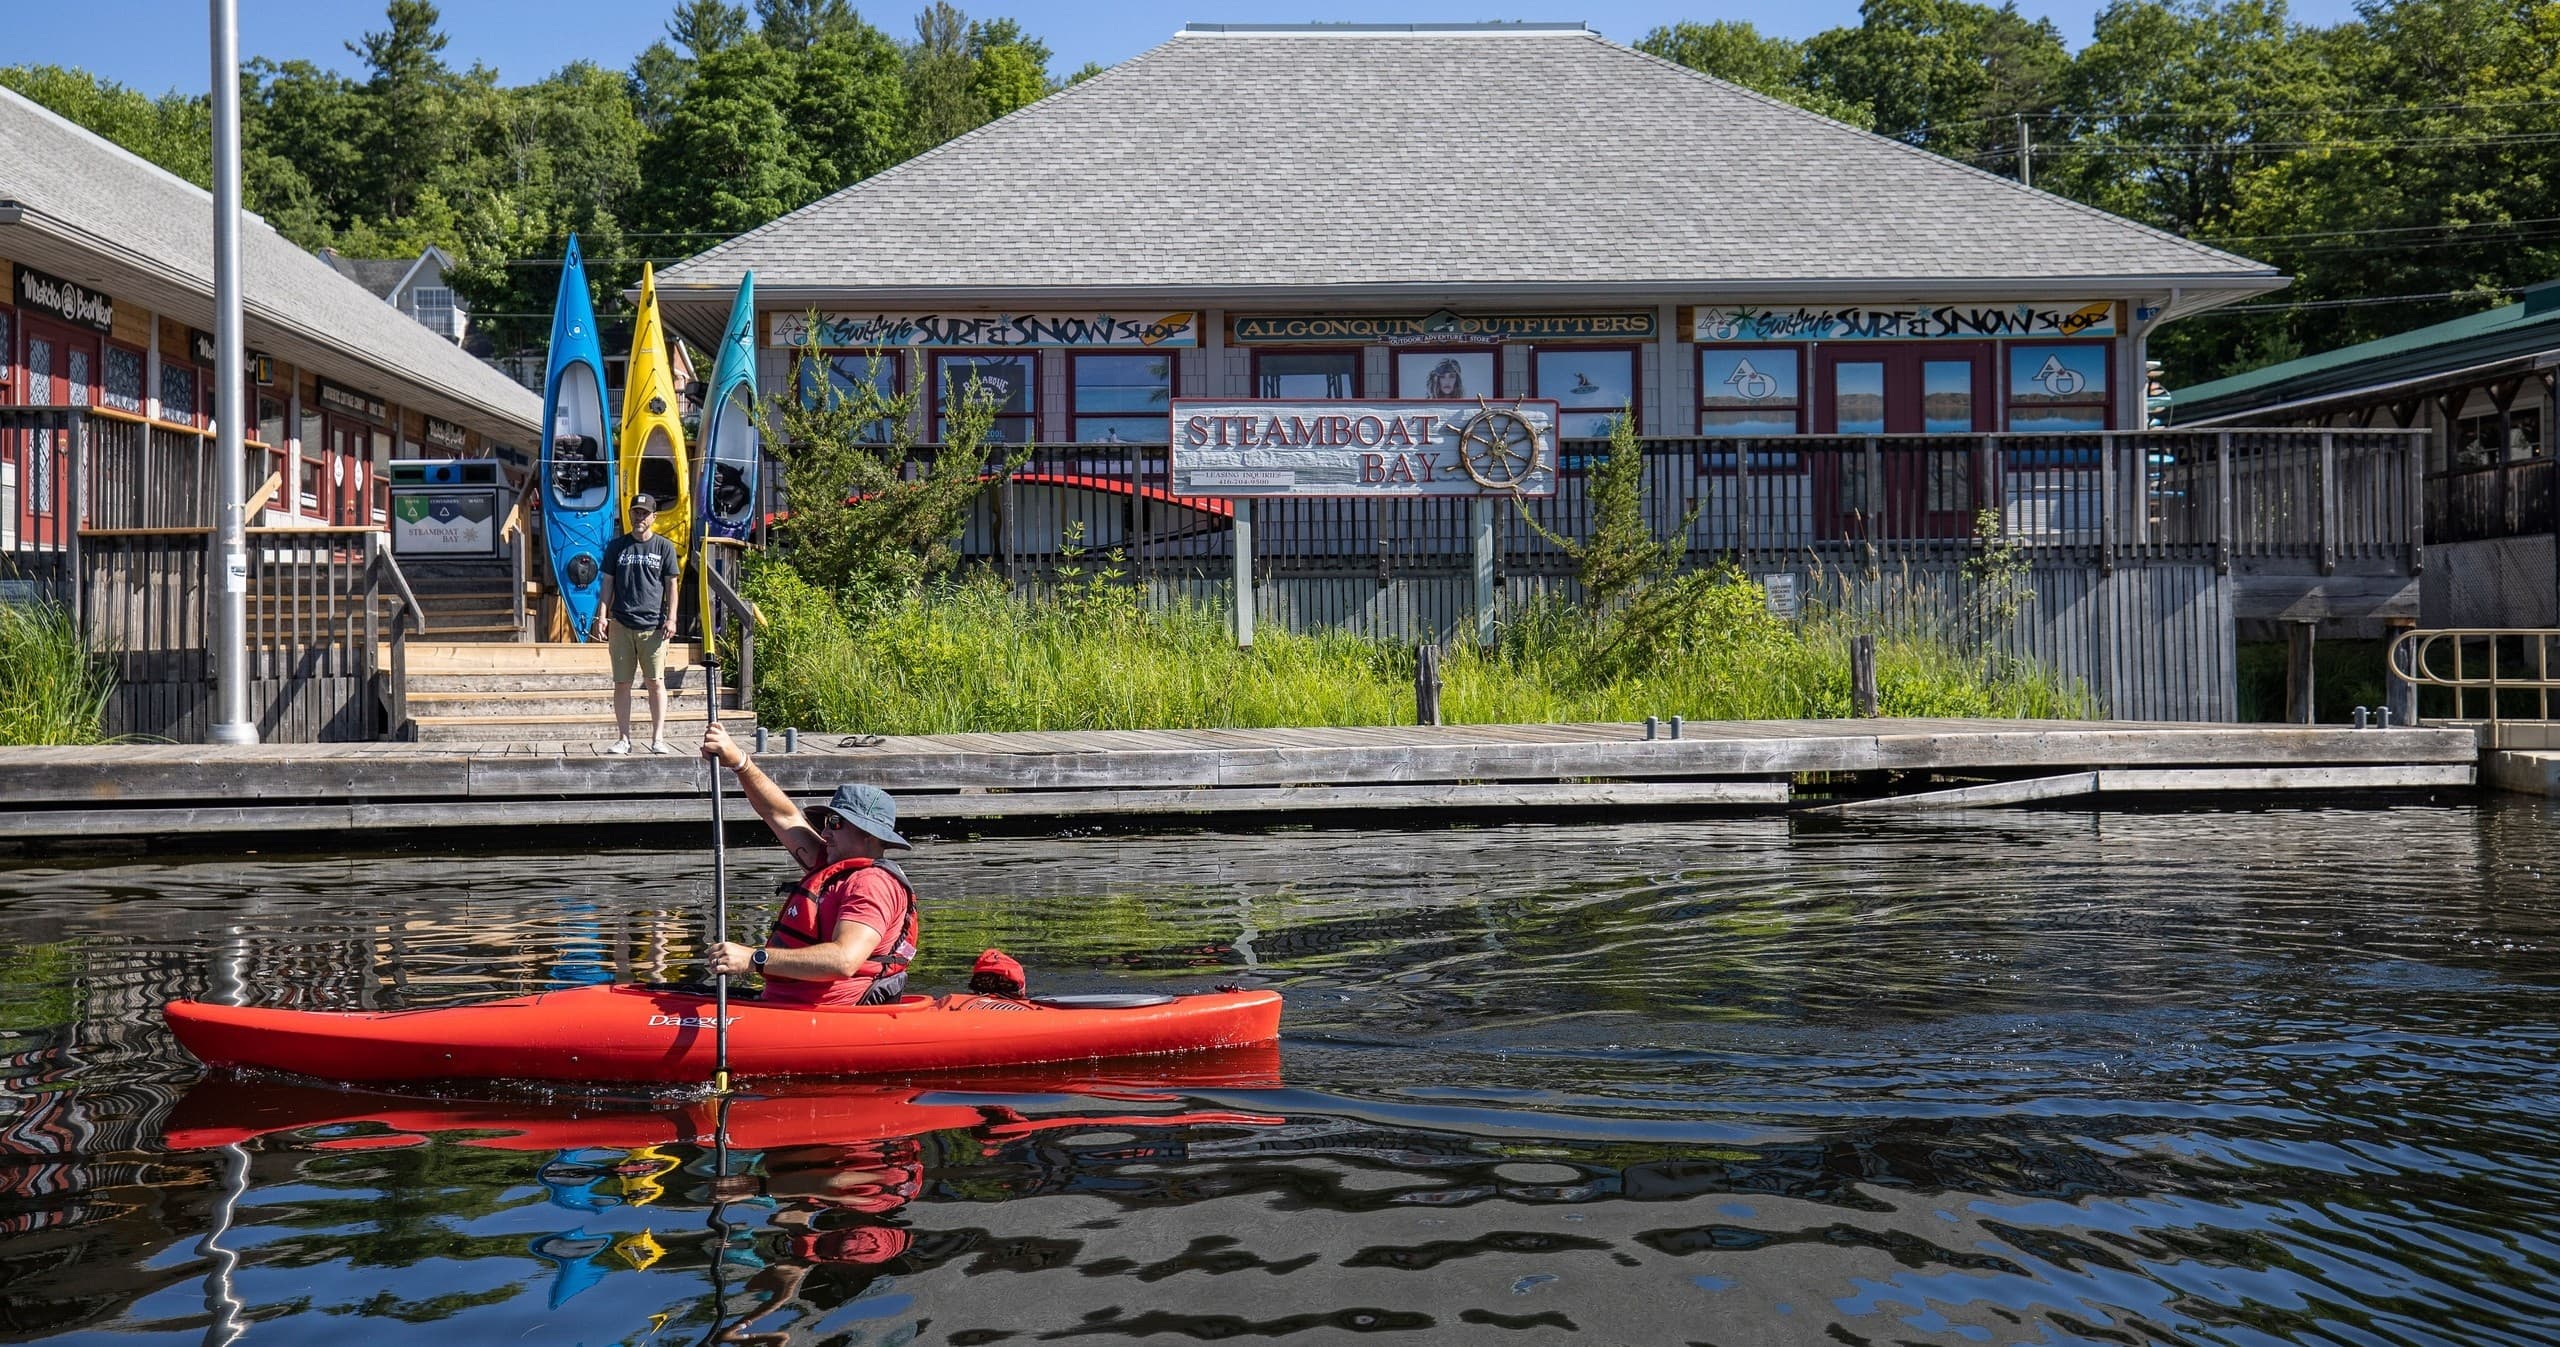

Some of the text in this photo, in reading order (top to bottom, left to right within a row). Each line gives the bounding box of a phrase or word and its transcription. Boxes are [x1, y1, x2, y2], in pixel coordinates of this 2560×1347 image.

[914, 314, 996, 345] SURF
[1011, 314, 1116, 345] SNOW
[1116, 319, 1191, 339] SHOP
[1241, 316, 1649, 336] ALGONQUIN OUTFITTERS
[1755, 307, 1835, 338] Swifty's
[1836, 307, 1916, 338] SURF
[1932, 306, 2035, 337] SNOW
[2036, 310, 2109, 330] SHOP
[1189, 414, 1440, 446] STEAMBOAT
[1242, 471, 1280, 479] INQUIRIES
[1360, 452, 1441, 483] BAY
[408, 528, 459, 536] STEAMBOAT
